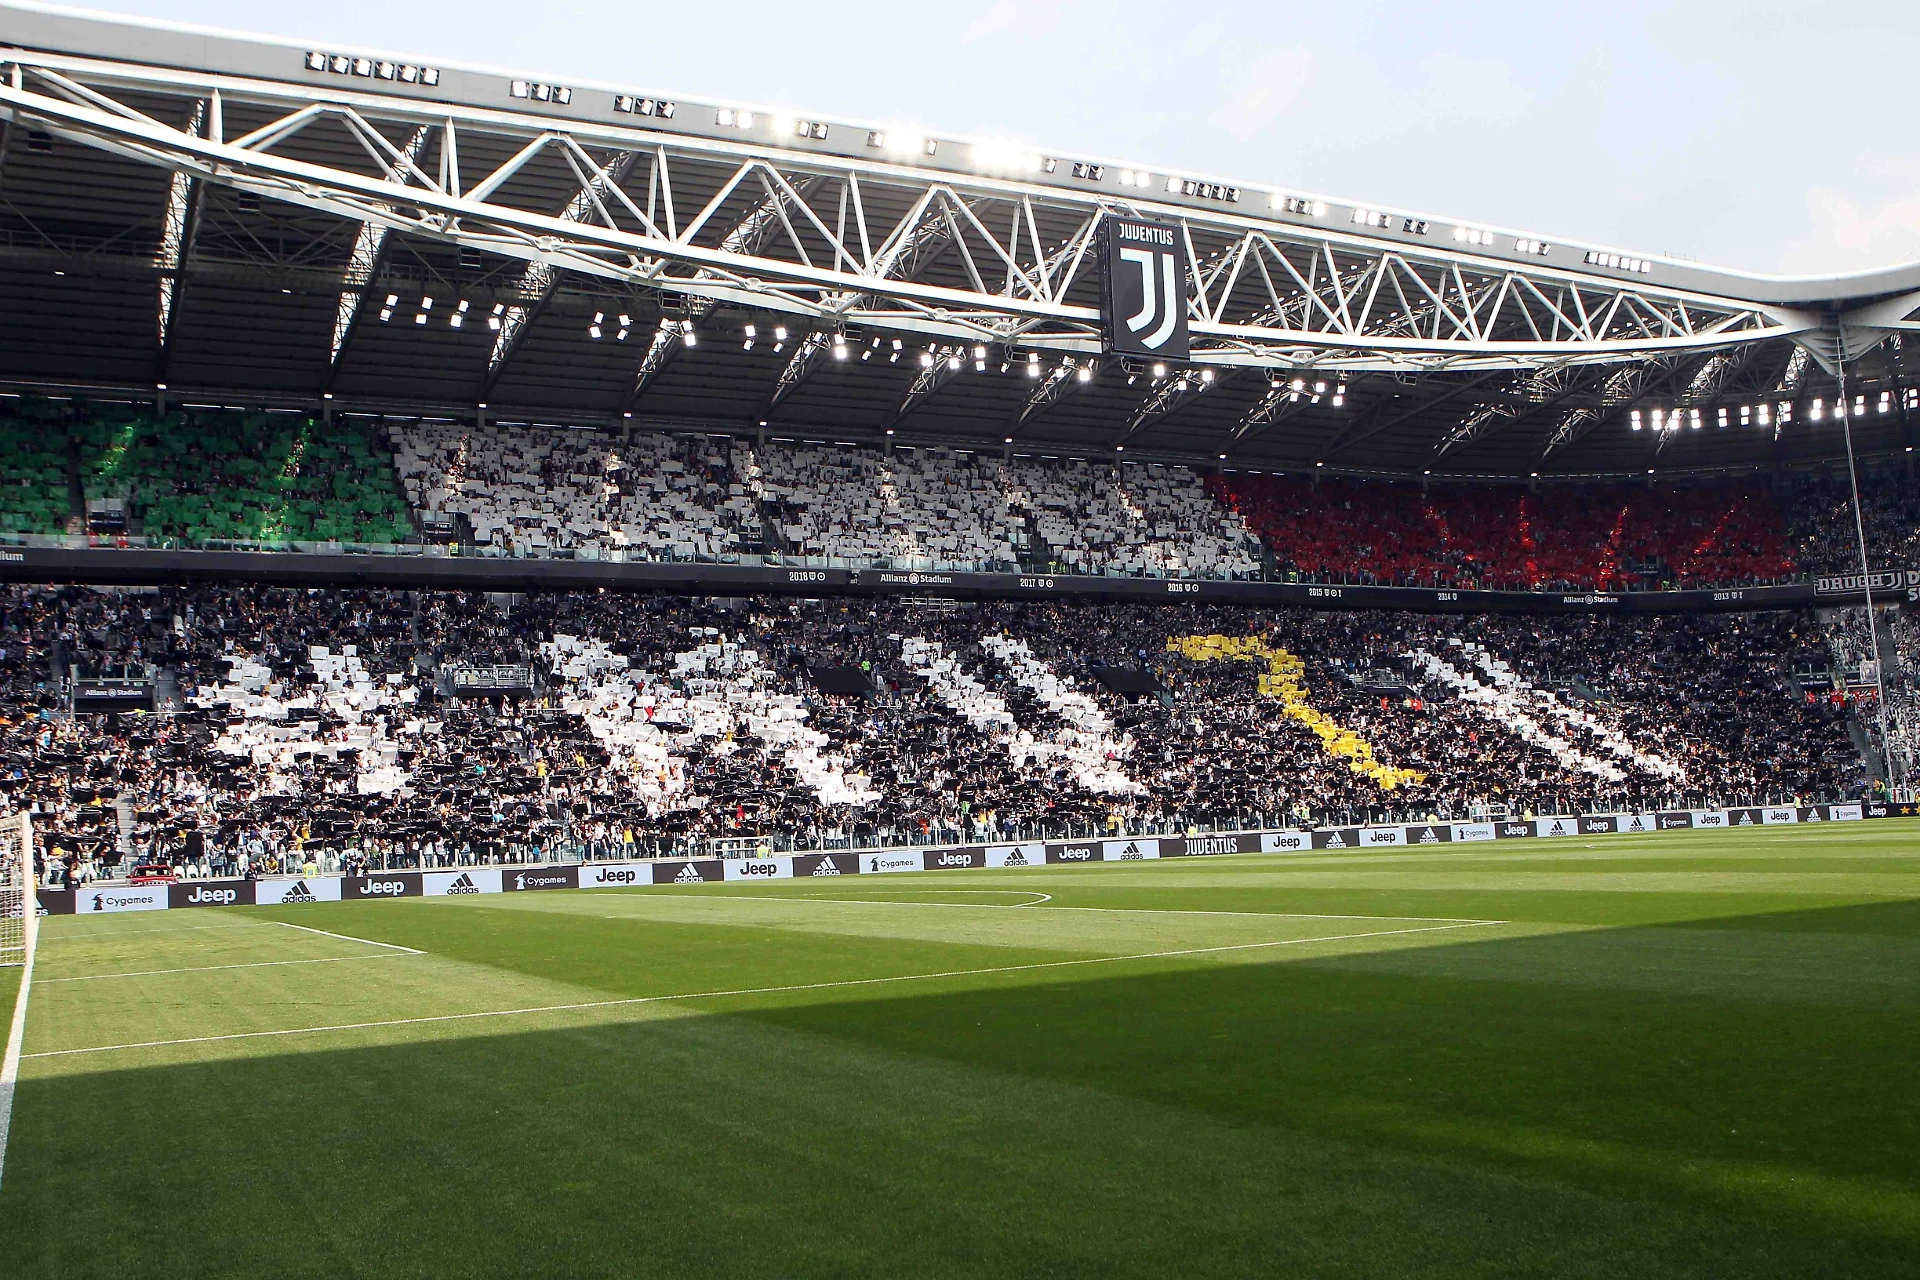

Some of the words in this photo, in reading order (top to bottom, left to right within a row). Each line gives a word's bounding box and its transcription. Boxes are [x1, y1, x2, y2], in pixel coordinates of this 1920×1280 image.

[1119, 223, 1174, 245] JUVENTUS
[789, 571, 808, 581] 2018
[880, 573, 908, 582] Allianz
[920, 574, 951, 584] Stadium
[1020, 578, 1036, 588] 2017
[1168, 583, 1183, 592] 2016
[1308, 587, 1323, 597] 2015
[1714, 592, 1729, 601] 2013
[1593, 595, 1619, 603] Stadium
[1771, 811, 1790, 822] Jeep
[1868, 806, 1887, 817] Jeep
[1701, 814, 1721, 825] Jeep
[1504, 824, 1528, 837] Jeep
[1587, 819, 1608, 832] Jeep
[1273, 836, 1301, 849] Jeep
[1371, 831, 1396, 843] Jeep
[1184, 837, 1238, 856] JUVENTUS
[1059, 846, 1091, 860] Jeep
[1120, 852, 1144, 860] adidas
[880, 859, 914, 868] Cygames
[938, 852, 972, 867] Jeep
[1004, 859, 1029, 867] adidas
[740, 862, 777, 877] Jeep
[812, 869, 841, 877] adidas
[527, 876, 567, 886] Cygames
[596, 868, 636, 884] Jeep
[674, 876, 704, 884] adidas
[360, 879, 405, 896] Jeep
[447, 886, 480, 895] adidas
[188, 887, 236, 904] Jeep
[281, 894, 317, 904] adidas
[106, 896, 153, 907] Cygames
